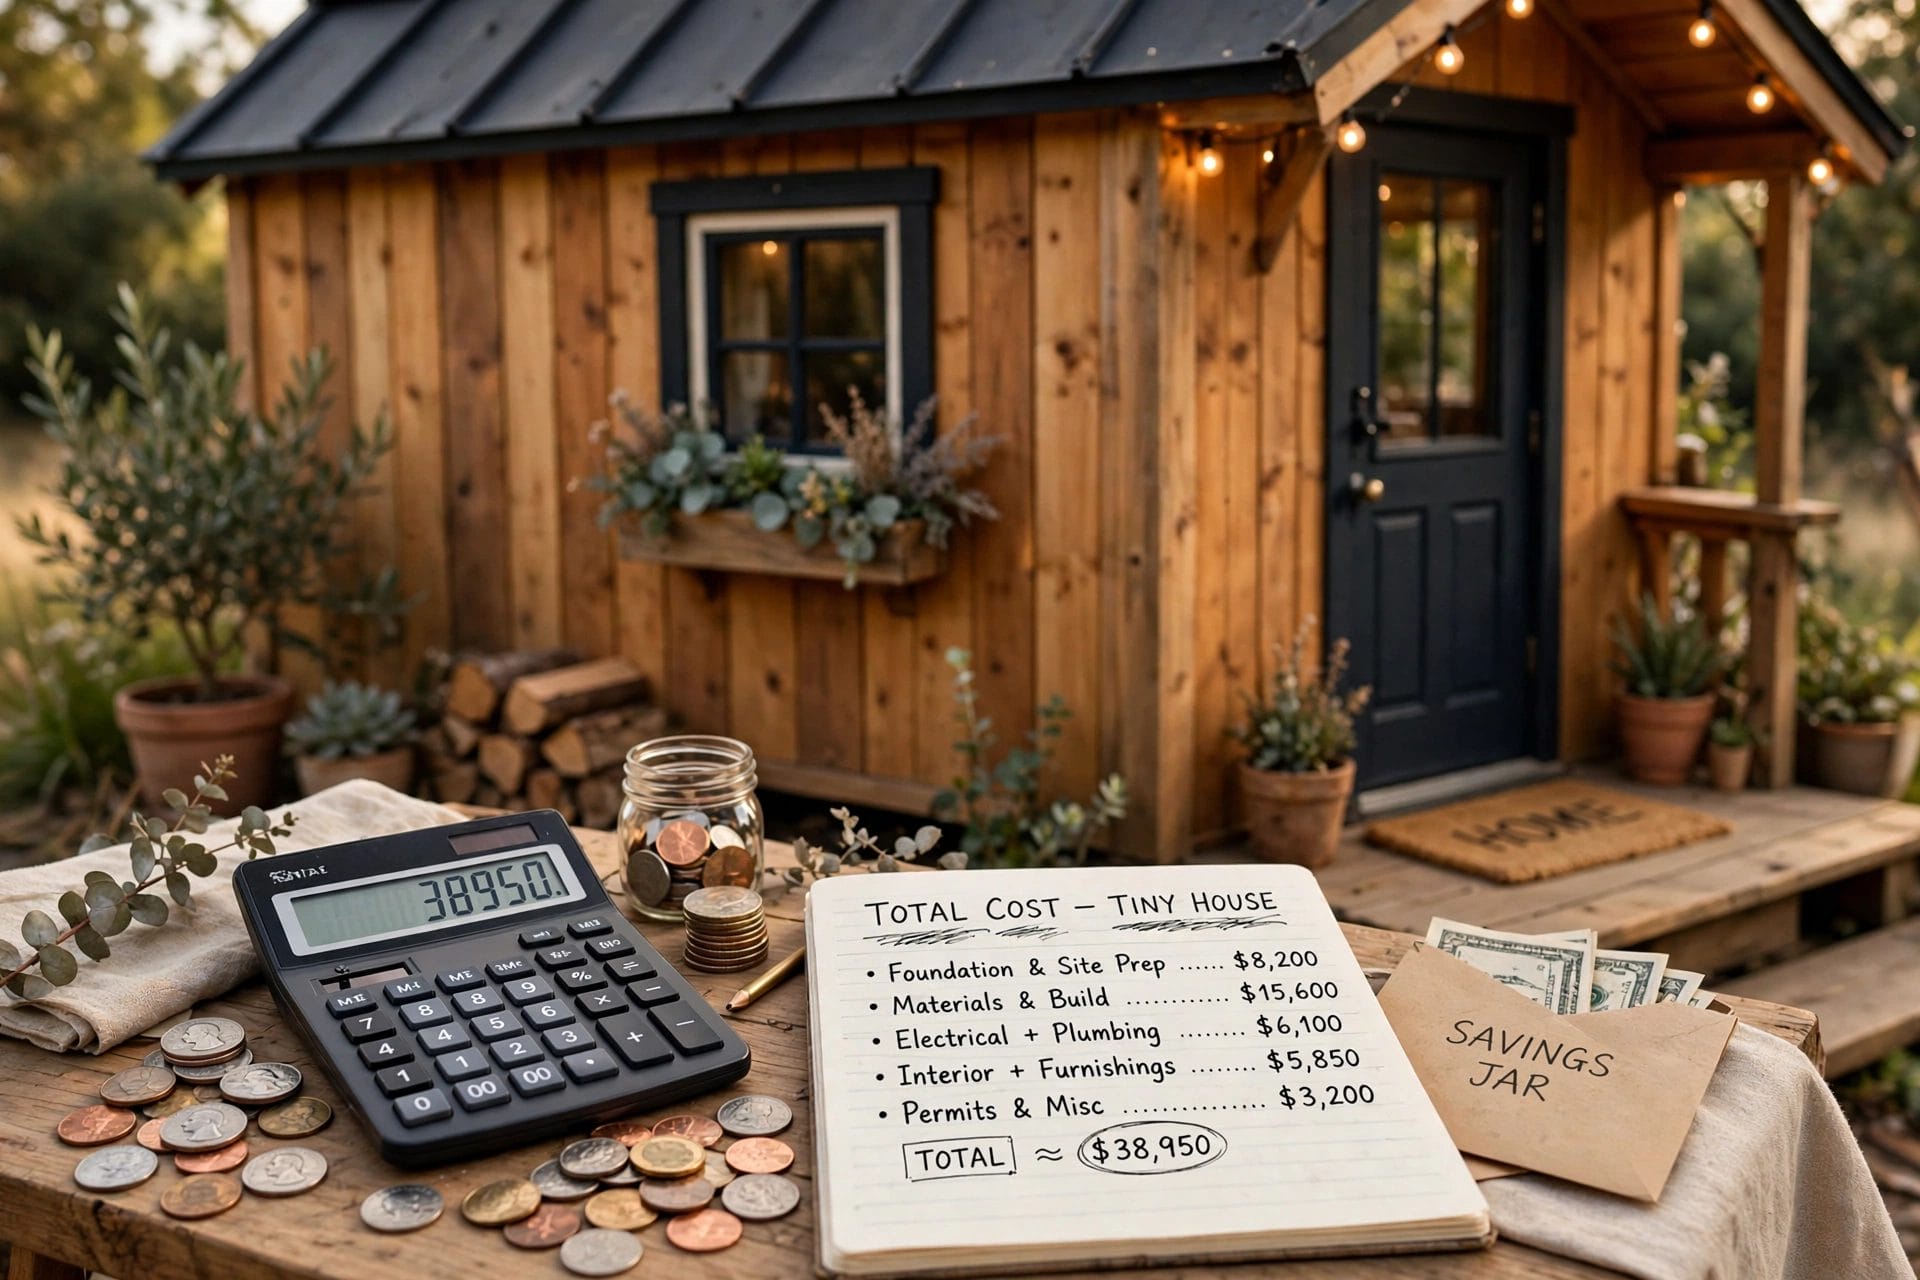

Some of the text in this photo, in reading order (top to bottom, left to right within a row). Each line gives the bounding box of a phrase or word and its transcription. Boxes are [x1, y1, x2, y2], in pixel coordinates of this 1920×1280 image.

[1451, 799, 1644, 852] HOME
[864, 901, 967, 926] TOTAL
[986, 897, 1060, 921] COST
[1107, 894, 1175, 916] TINY
[1190, 891, 1278, 913] HOUSE
[888, 950, 1318, 983] Foundation & Site Prep $8,200
[520, 981, 537, 994] 9
[470, 992, 487, 1005] 8
[893, 981, 1338, 1016] Materials & Build $15,600
[417, 1005, 434, 1017] 8
[540, 1005, 557, 1017] 6
[358, 1017, 373, 1030] 7
[488, 1016, 505, 1030] 5
[437, 1028, 453, 1041] 4
[561, 1030, 578, 1043] 3
[895, 1014, 1342, 1050] Electrical + Plumbing $6,100
[378, 1042, 395, 1054] 4
[508, 1042, 527, 1056] 2
[1446, 1020, 1614, 1077] SAVINGS
[455, 1055, 469, 1068] 1
[897, 1048, 1360, 1086] Interior + Furnishings $5,850
[397, 1069, 410, 1082] 1
[522, 1067, 552, 1084] 00
[1469, 1061, 1550, 1101] JAR
[467, 1080, 497, 1098] 00
[413, 1096, 431, 1111] 0
[901, 1084, 1375, 1125] Permits & Misc $3,200
[914, 1146, 1006, 1171] TOTAL
[1092, 1134, 1211, 1164] $38,950
